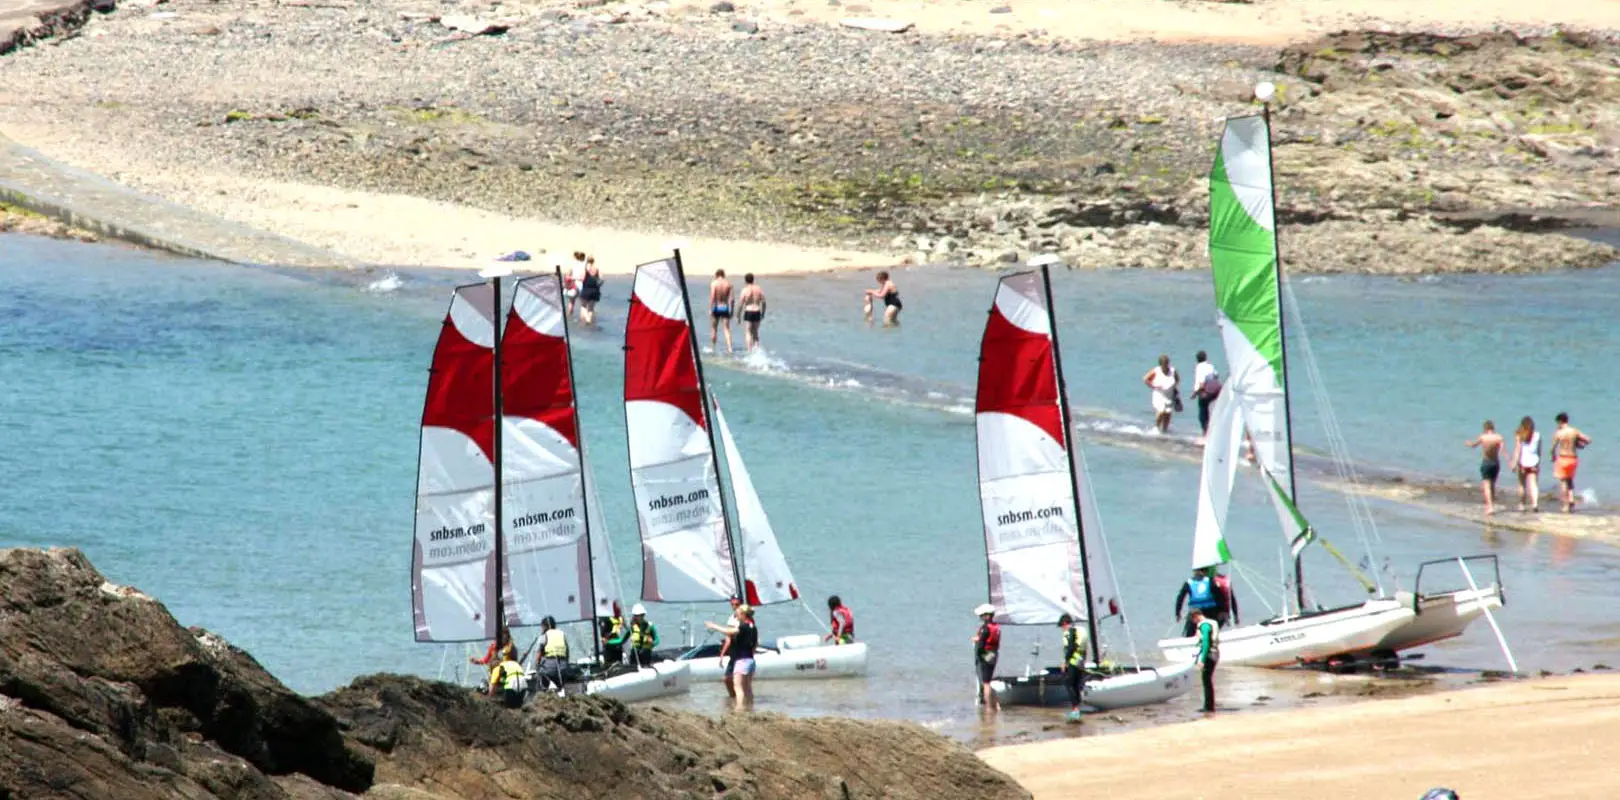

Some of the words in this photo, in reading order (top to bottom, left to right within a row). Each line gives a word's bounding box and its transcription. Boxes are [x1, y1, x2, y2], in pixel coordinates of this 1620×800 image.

[648, 488, 709, 511] snbsm.com
[512, 507, 575, 529] snbsm.com
[997, 506, 1063, 526] snbsm.com
[430, 523, 485, 542] snbsm.com
